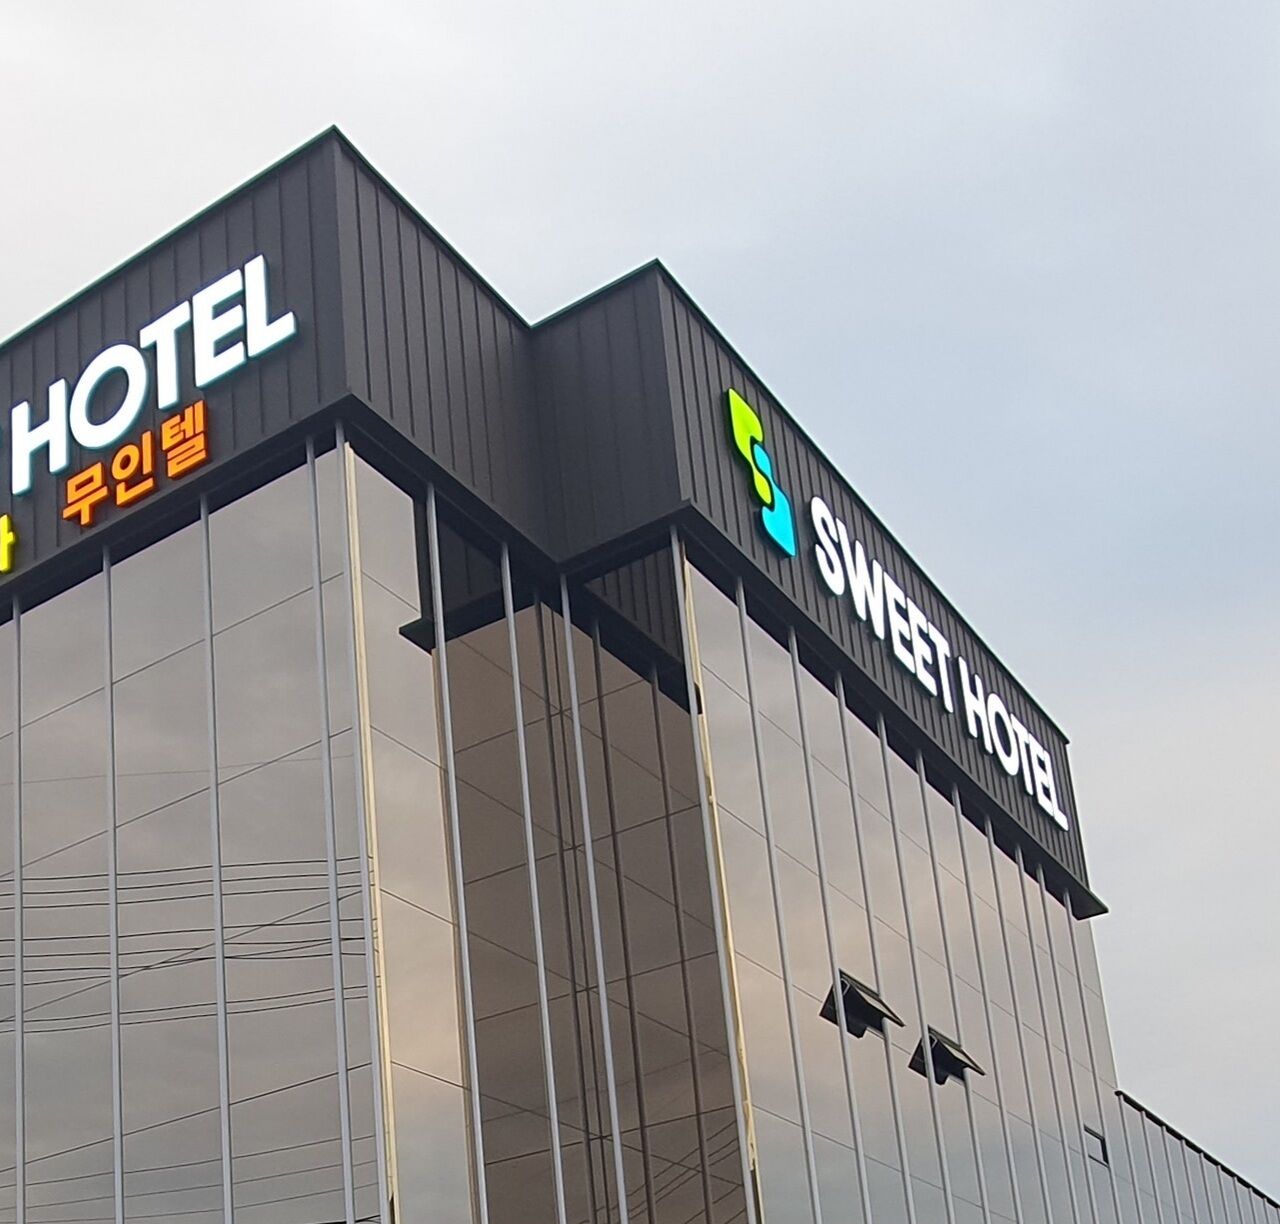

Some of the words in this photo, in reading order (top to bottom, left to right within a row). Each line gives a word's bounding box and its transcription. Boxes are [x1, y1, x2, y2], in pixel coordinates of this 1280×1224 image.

[11, 255, 297, 496] HOTEL
[62, 401, 210, 527] 무인텔
[810, 496, 953, 713] SWEET
[958, 656, 1068, 831] HOTEL
